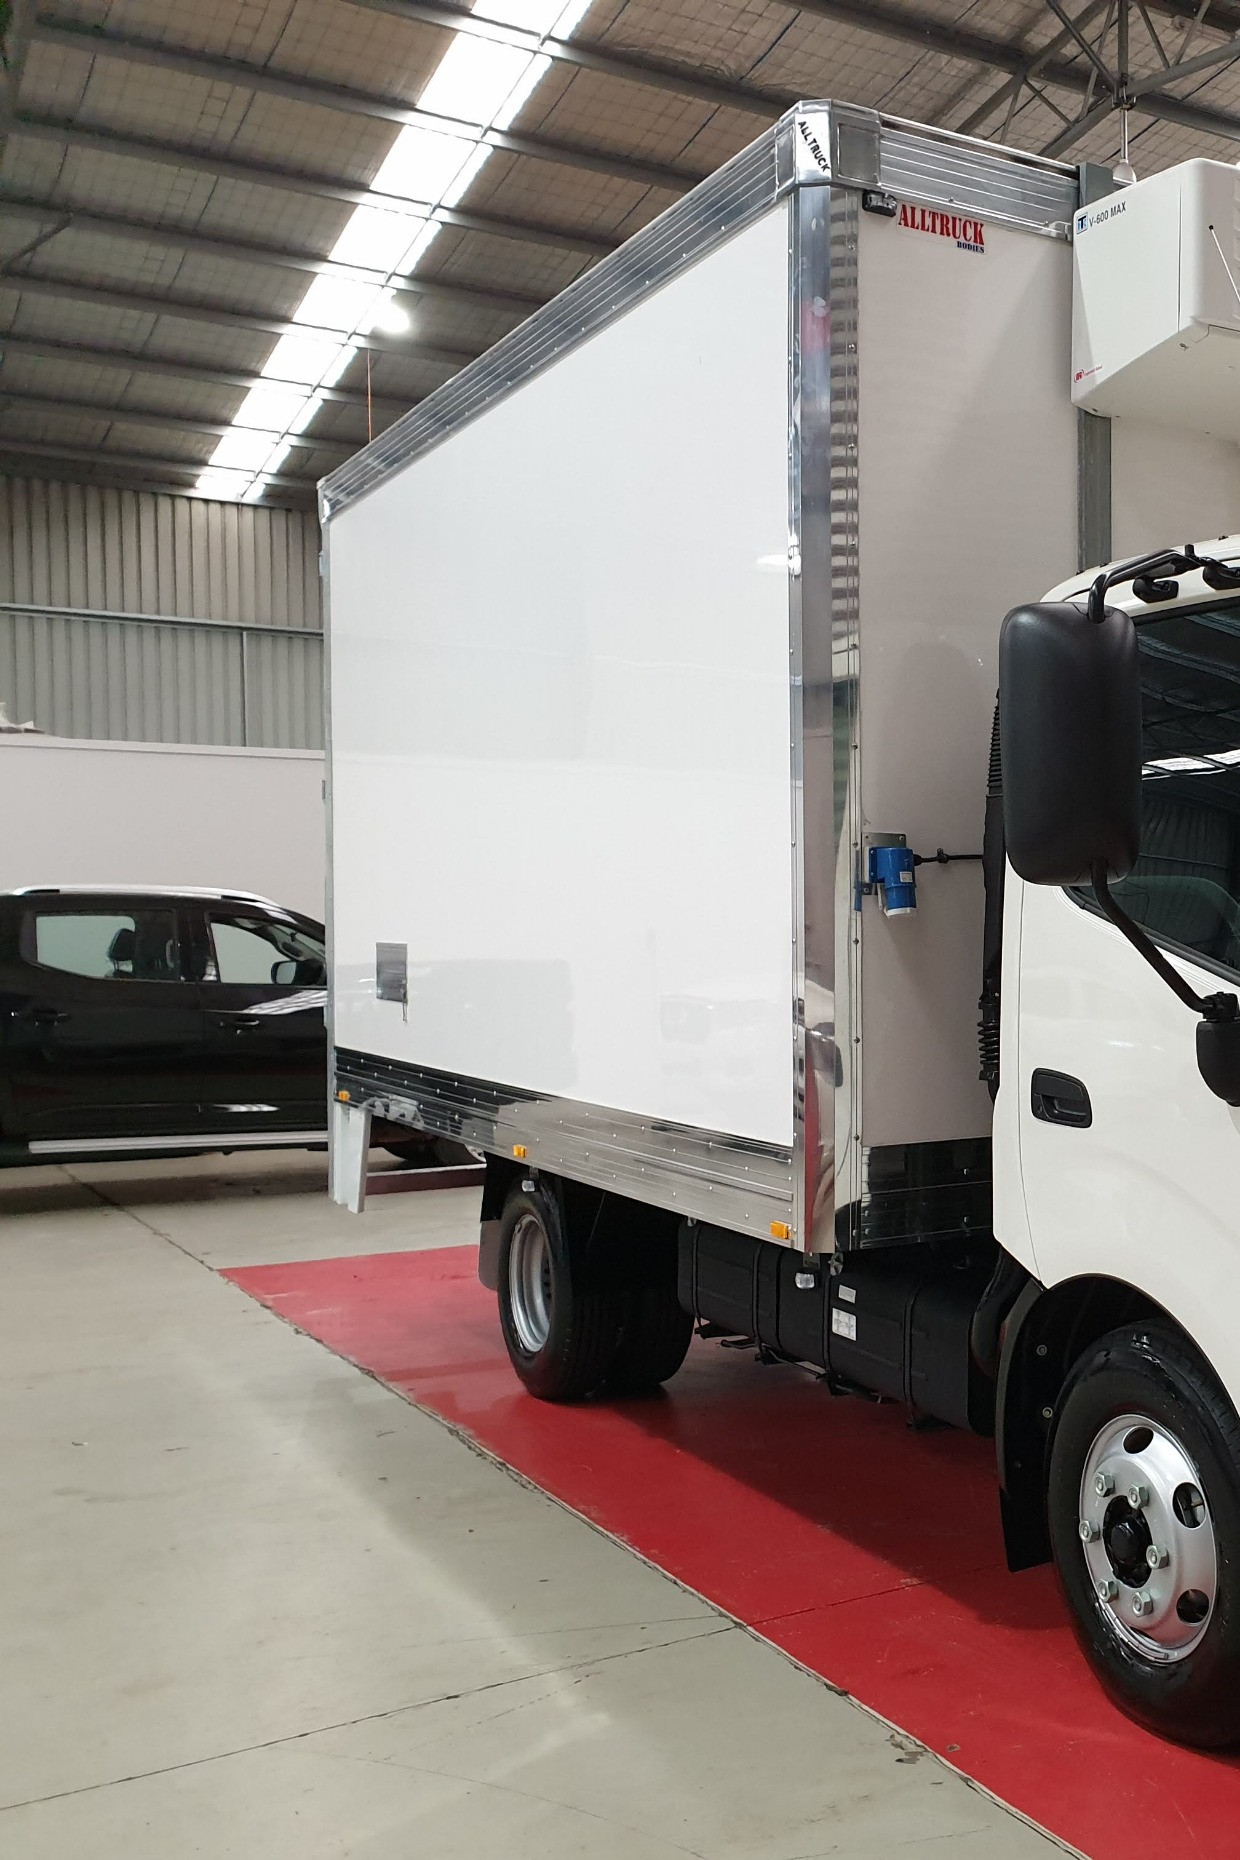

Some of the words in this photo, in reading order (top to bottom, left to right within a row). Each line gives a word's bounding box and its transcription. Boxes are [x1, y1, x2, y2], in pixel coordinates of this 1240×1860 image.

[797, 120, 831, 173] ALLTRUCK
[897, 203, 985, 246] ALLTRUCK
[1110, 201, 1127, 218] MAX
[956, 240, 985, 255] BODIES
